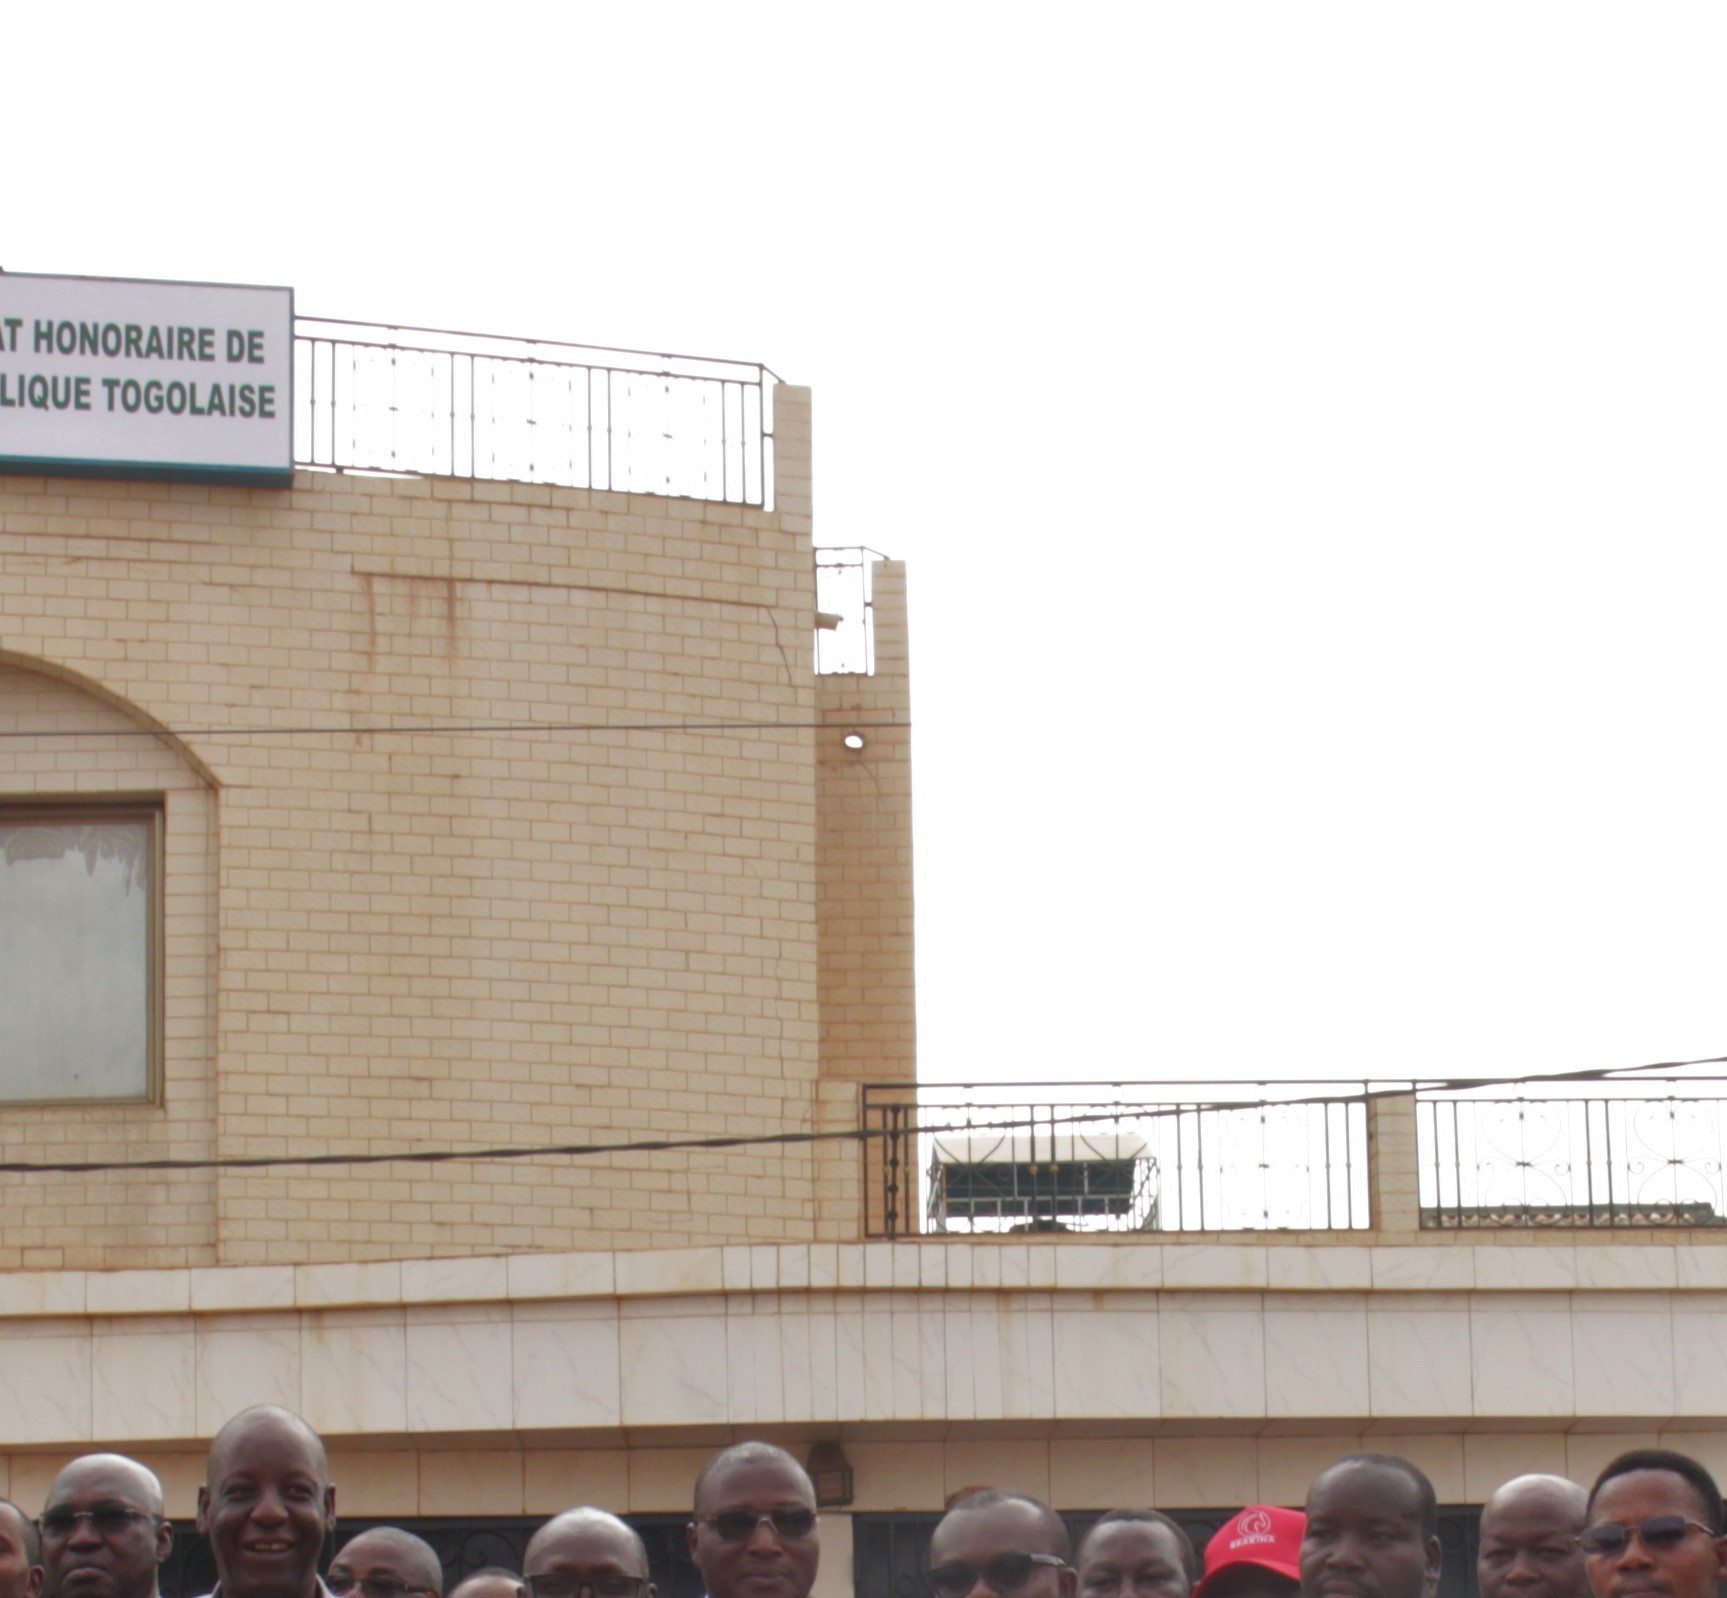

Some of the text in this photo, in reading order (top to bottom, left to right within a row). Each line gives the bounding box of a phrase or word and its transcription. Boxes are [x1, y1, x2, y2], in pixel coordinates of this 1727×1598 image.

[34, 320, 215, 361] HONORAIRE
[227, 330, 264, 364] DE
[102, 378, 275, 419] TOGOLAISE
